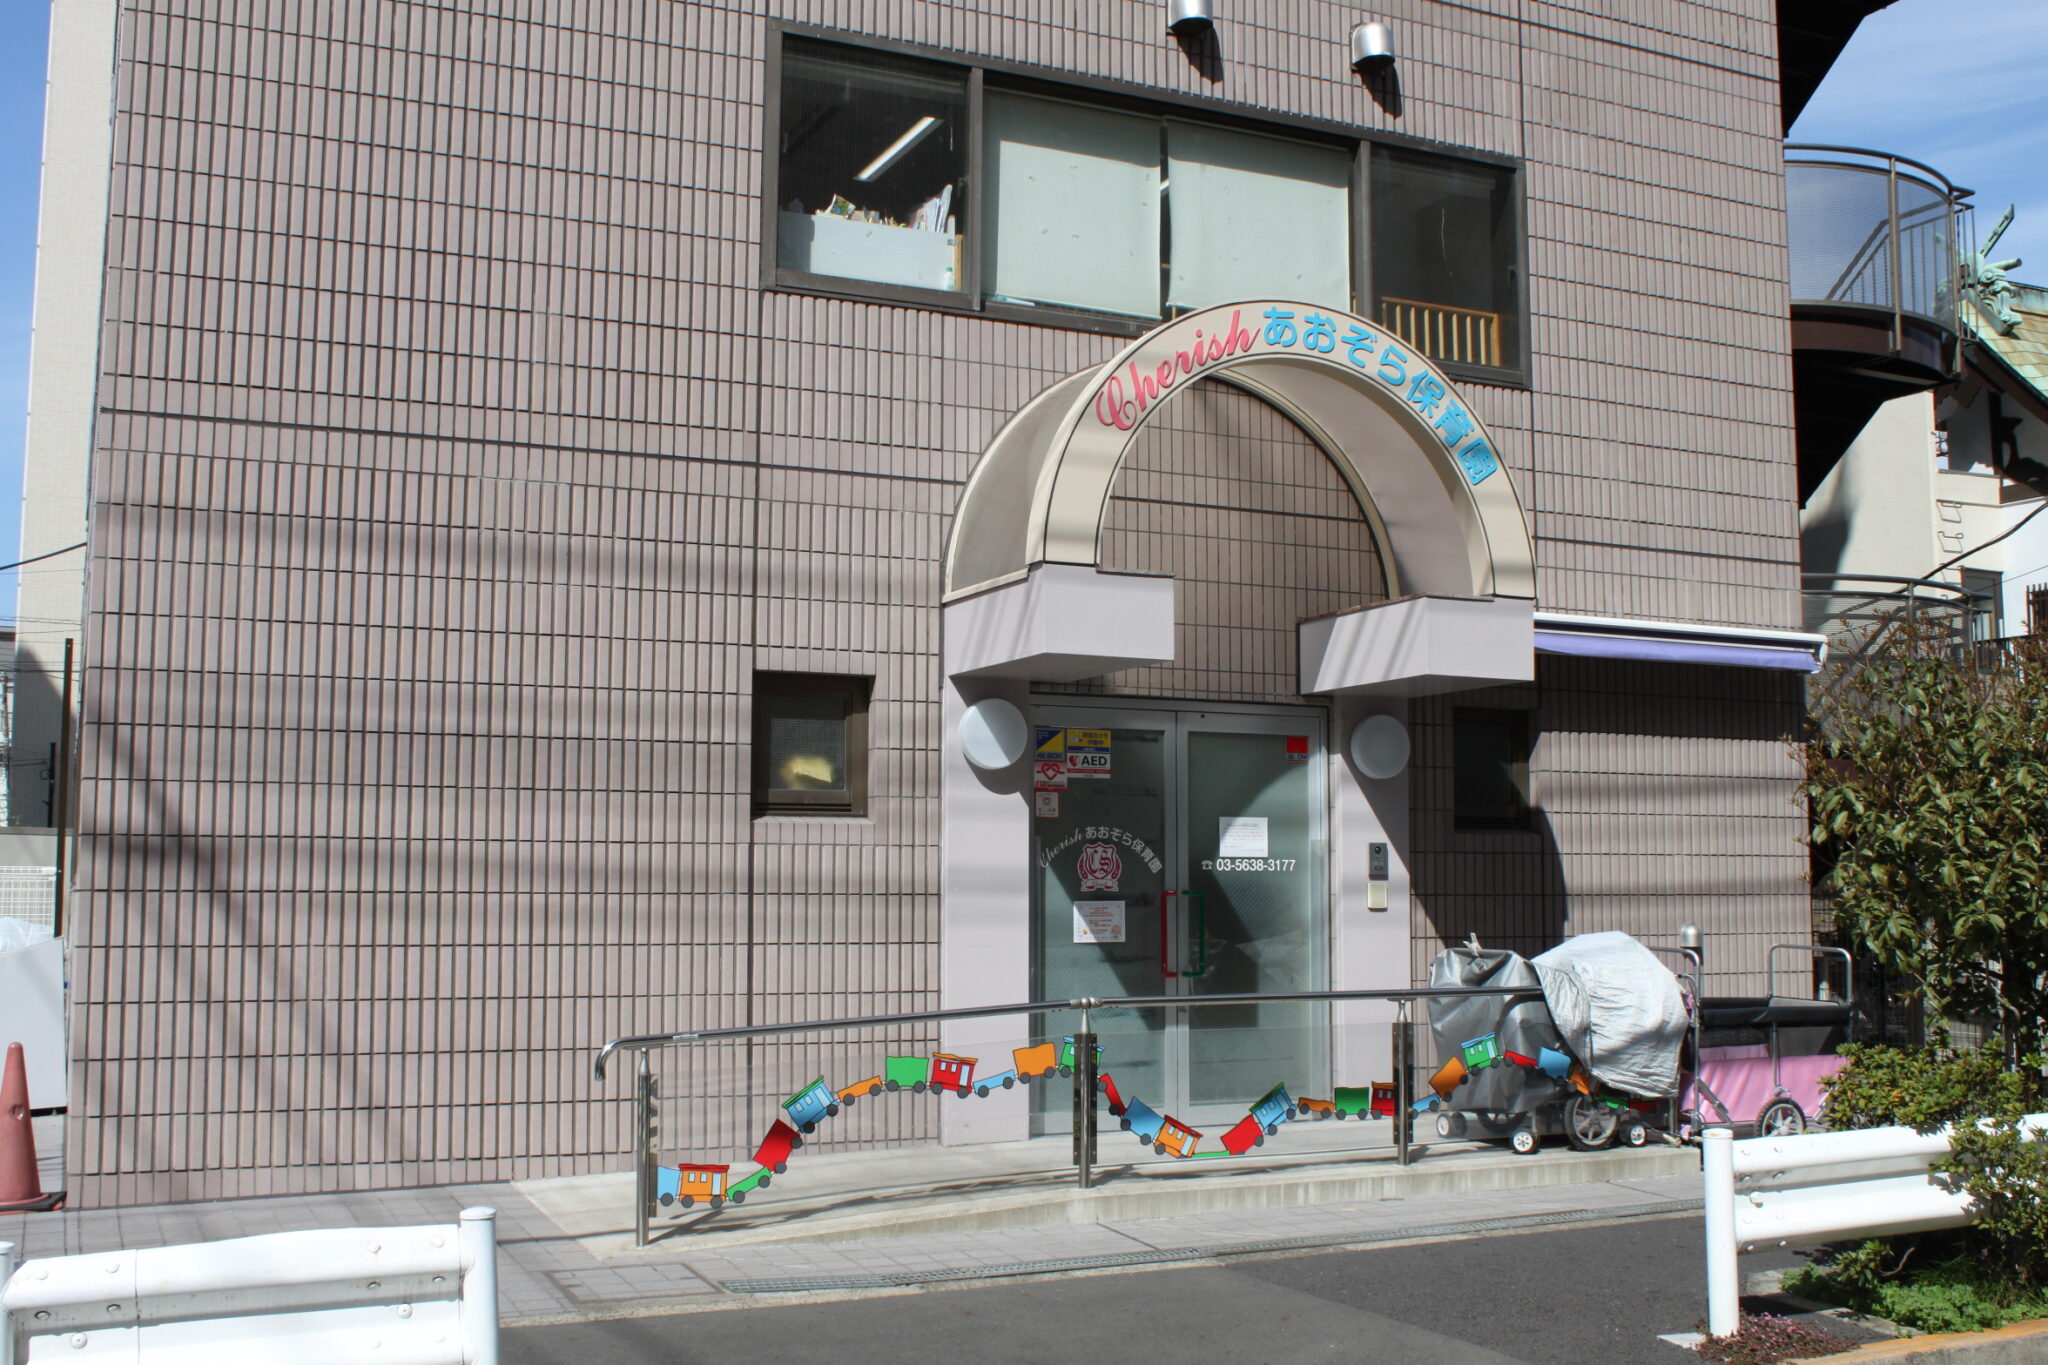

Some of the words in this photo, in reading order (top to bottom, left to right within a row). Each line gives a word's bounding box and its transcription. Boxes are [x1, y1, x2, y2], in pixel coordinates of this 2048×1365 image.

[1096, 309, 1261, 430] Cherish
[1263, 306, 1498, 486] あおぞら保育園
[1081, 755, 1107, 766] AED
[1040, 827, 1083, 868] Cherish
[1216, 858, 1296, 872] 03-5638-3177
